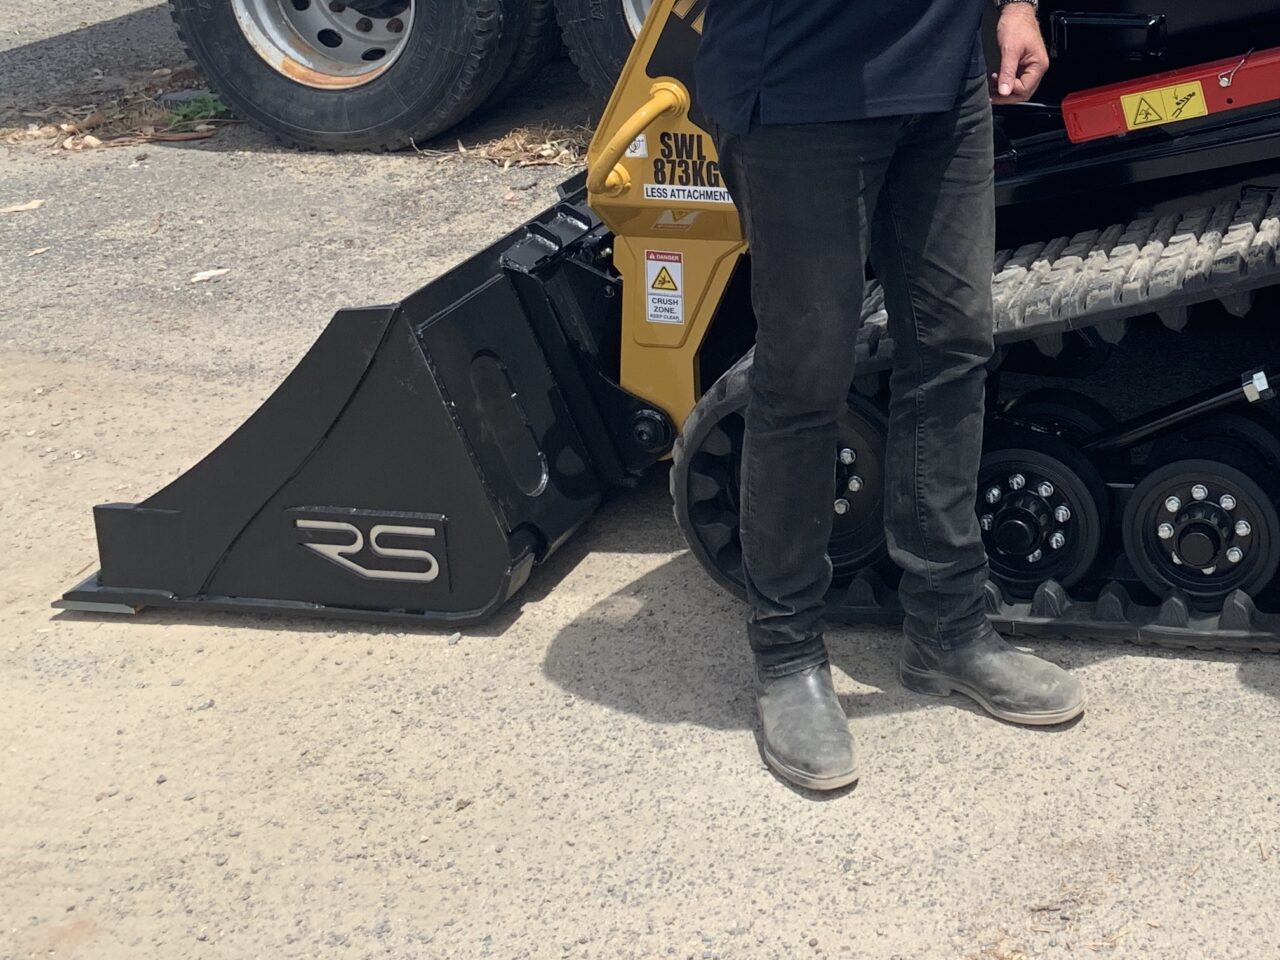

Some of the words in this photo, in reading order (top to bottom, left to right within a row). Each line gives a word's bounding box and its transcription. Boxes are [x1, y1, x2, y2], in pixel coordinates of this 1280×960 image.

[660, 131, 706, 161] SWL
[653, 158, 720, 188] 873KG
[645, 187, 668, 198] LESS
[670, 188, 731, 201] ATTACHMENT
[656, 253, 679, 261] DANGER
[651, 297, 679, 306] CRUSH
[296, 519, 440, 581] RS
